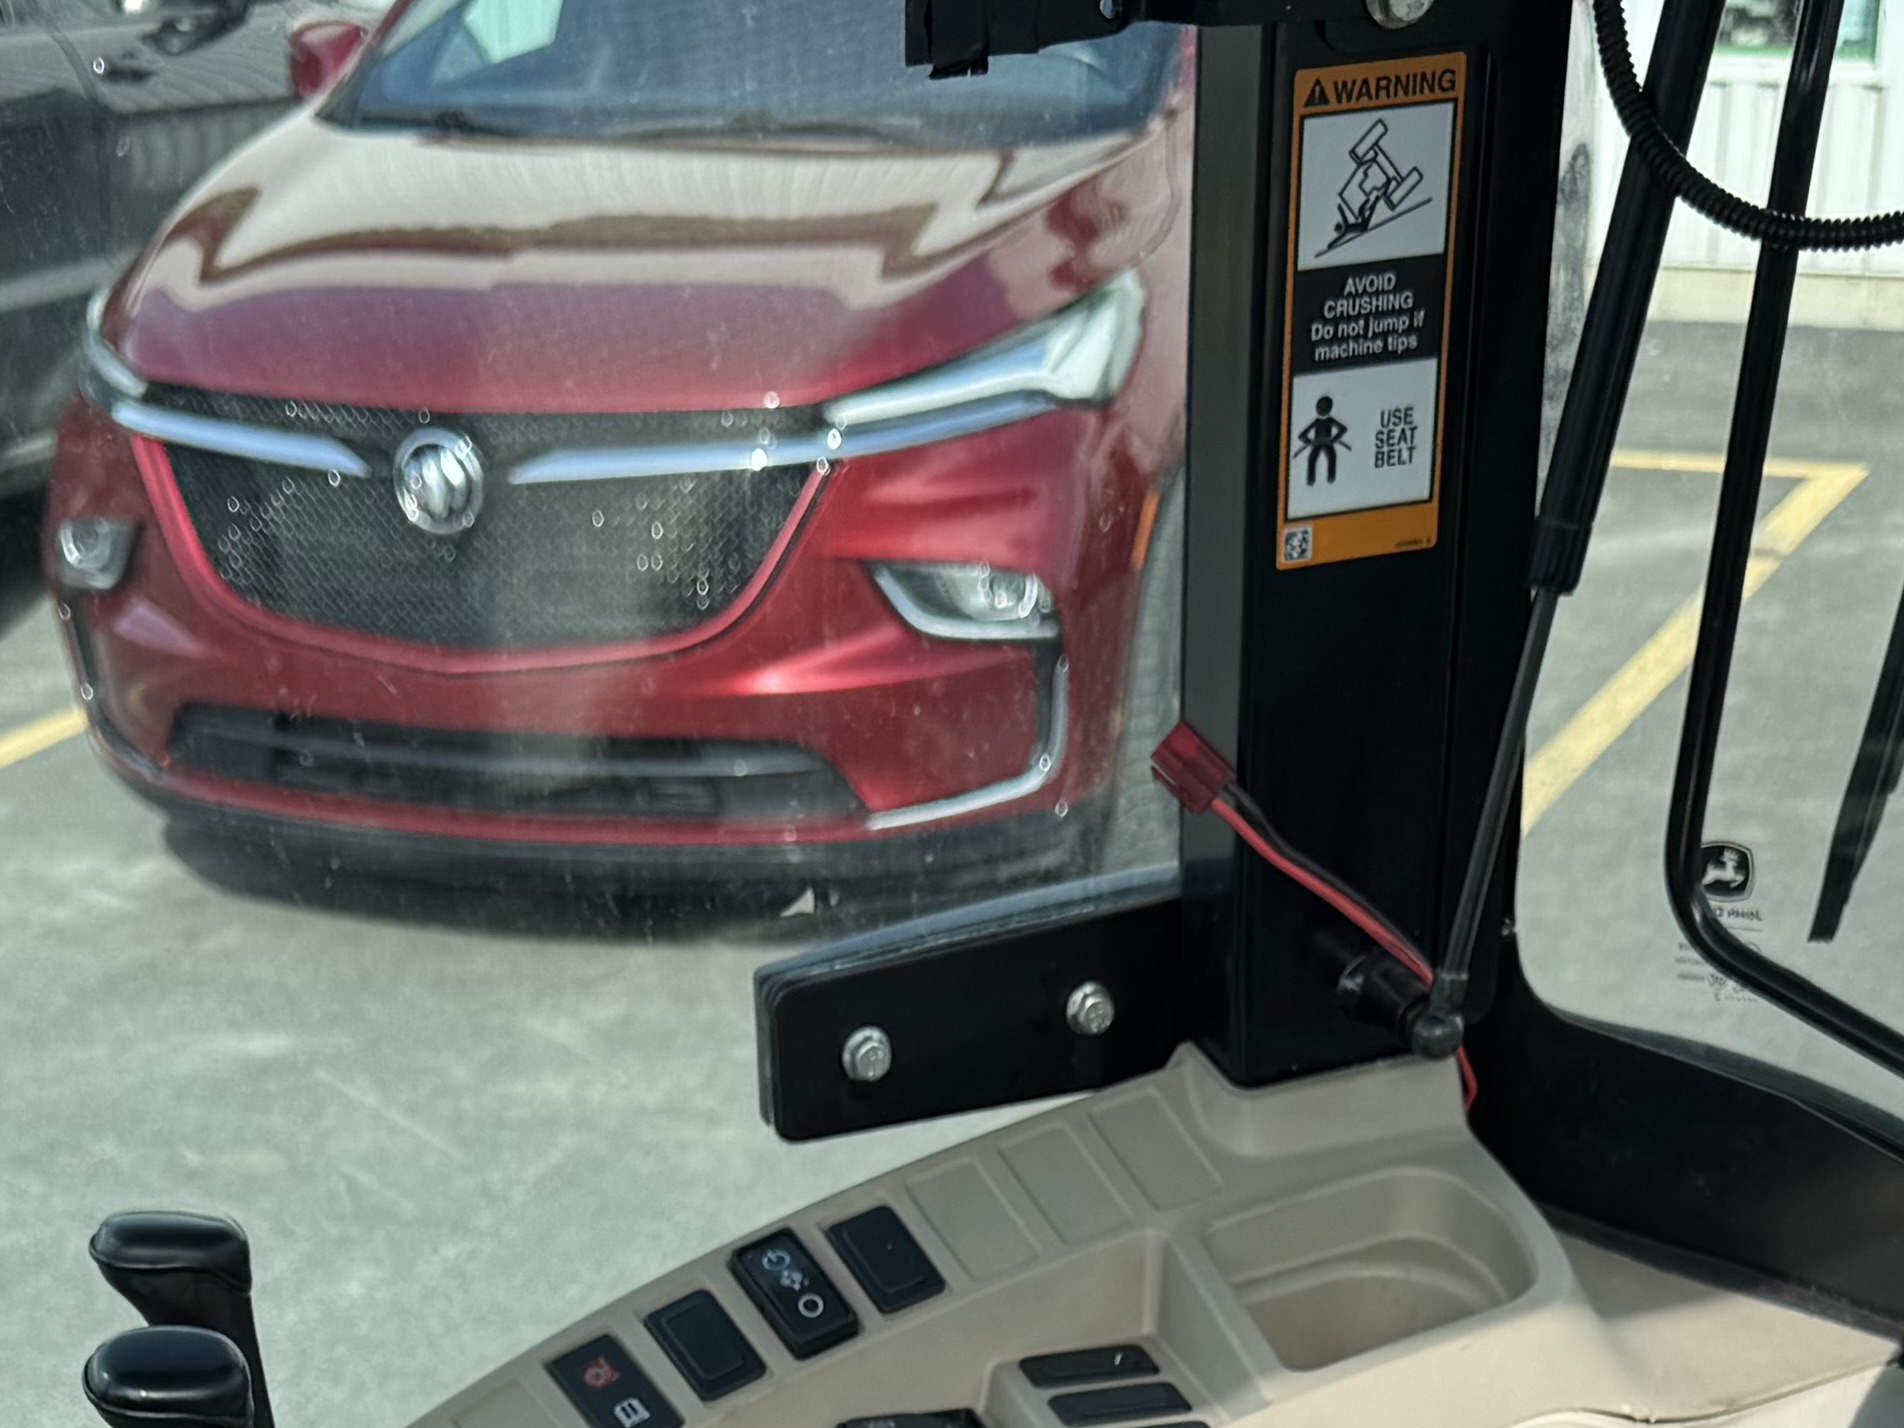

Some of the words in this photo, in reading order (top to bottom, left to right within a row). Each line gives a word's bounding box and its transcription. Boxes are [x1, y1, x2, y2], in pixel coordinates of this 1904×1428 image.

[1332, 68, 1457, 105] WARNING
[1343, 272, 1396, 297] AVOID
[1323, 291, 1414, 319] CRUSHING
[1311, 323, 1335, 341] Do
[1337, 319, 1365, 339] not
[1367, 315, 1410, 339] jump
[1413, 308, 1426, 328] if
[1315, 338, 1384, 361] machine
[1387, 333, 1418, 355] tips
[1380, 406, 1414, 429] USE
[1375, 426, 1418, 450] SEAT
[1374, 446, 1416, 469] BELT
